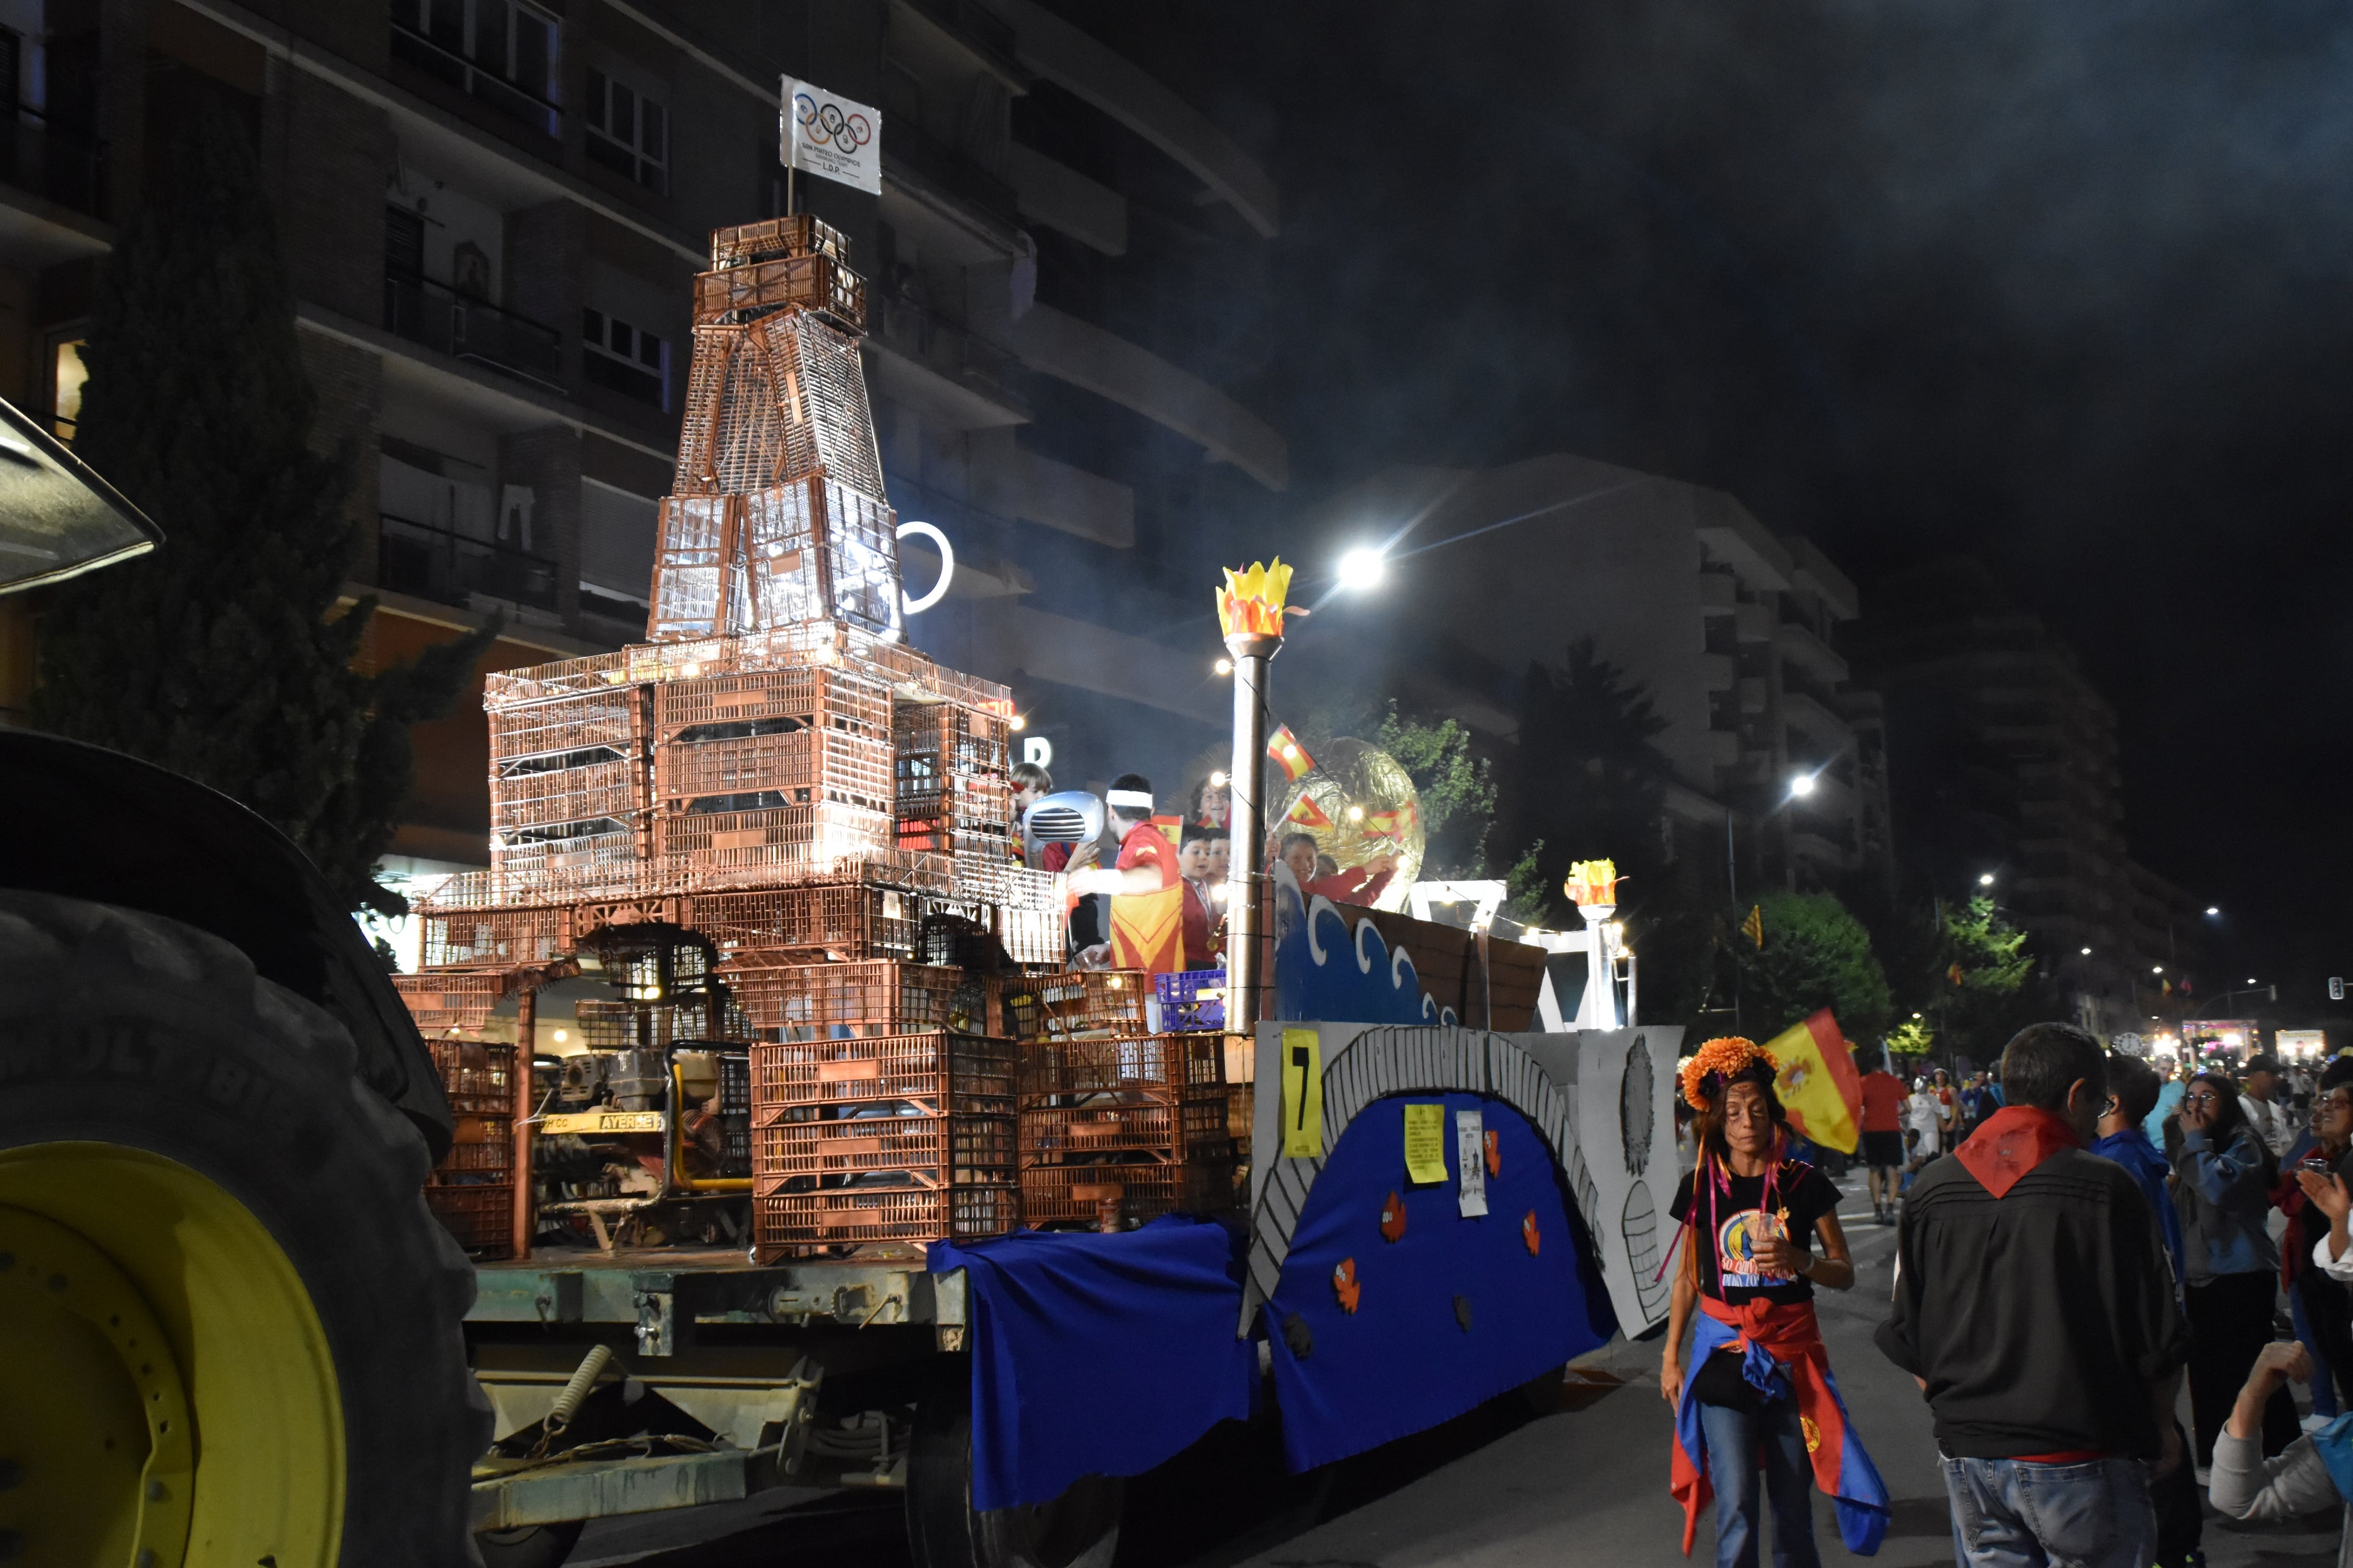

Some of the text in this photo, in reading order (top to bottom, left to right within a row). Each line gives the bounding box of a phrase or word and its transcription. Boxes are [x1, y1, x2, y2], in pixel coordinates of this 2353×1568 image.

[802, 142, 861, 167] SAN MATEO OLYMPICS
